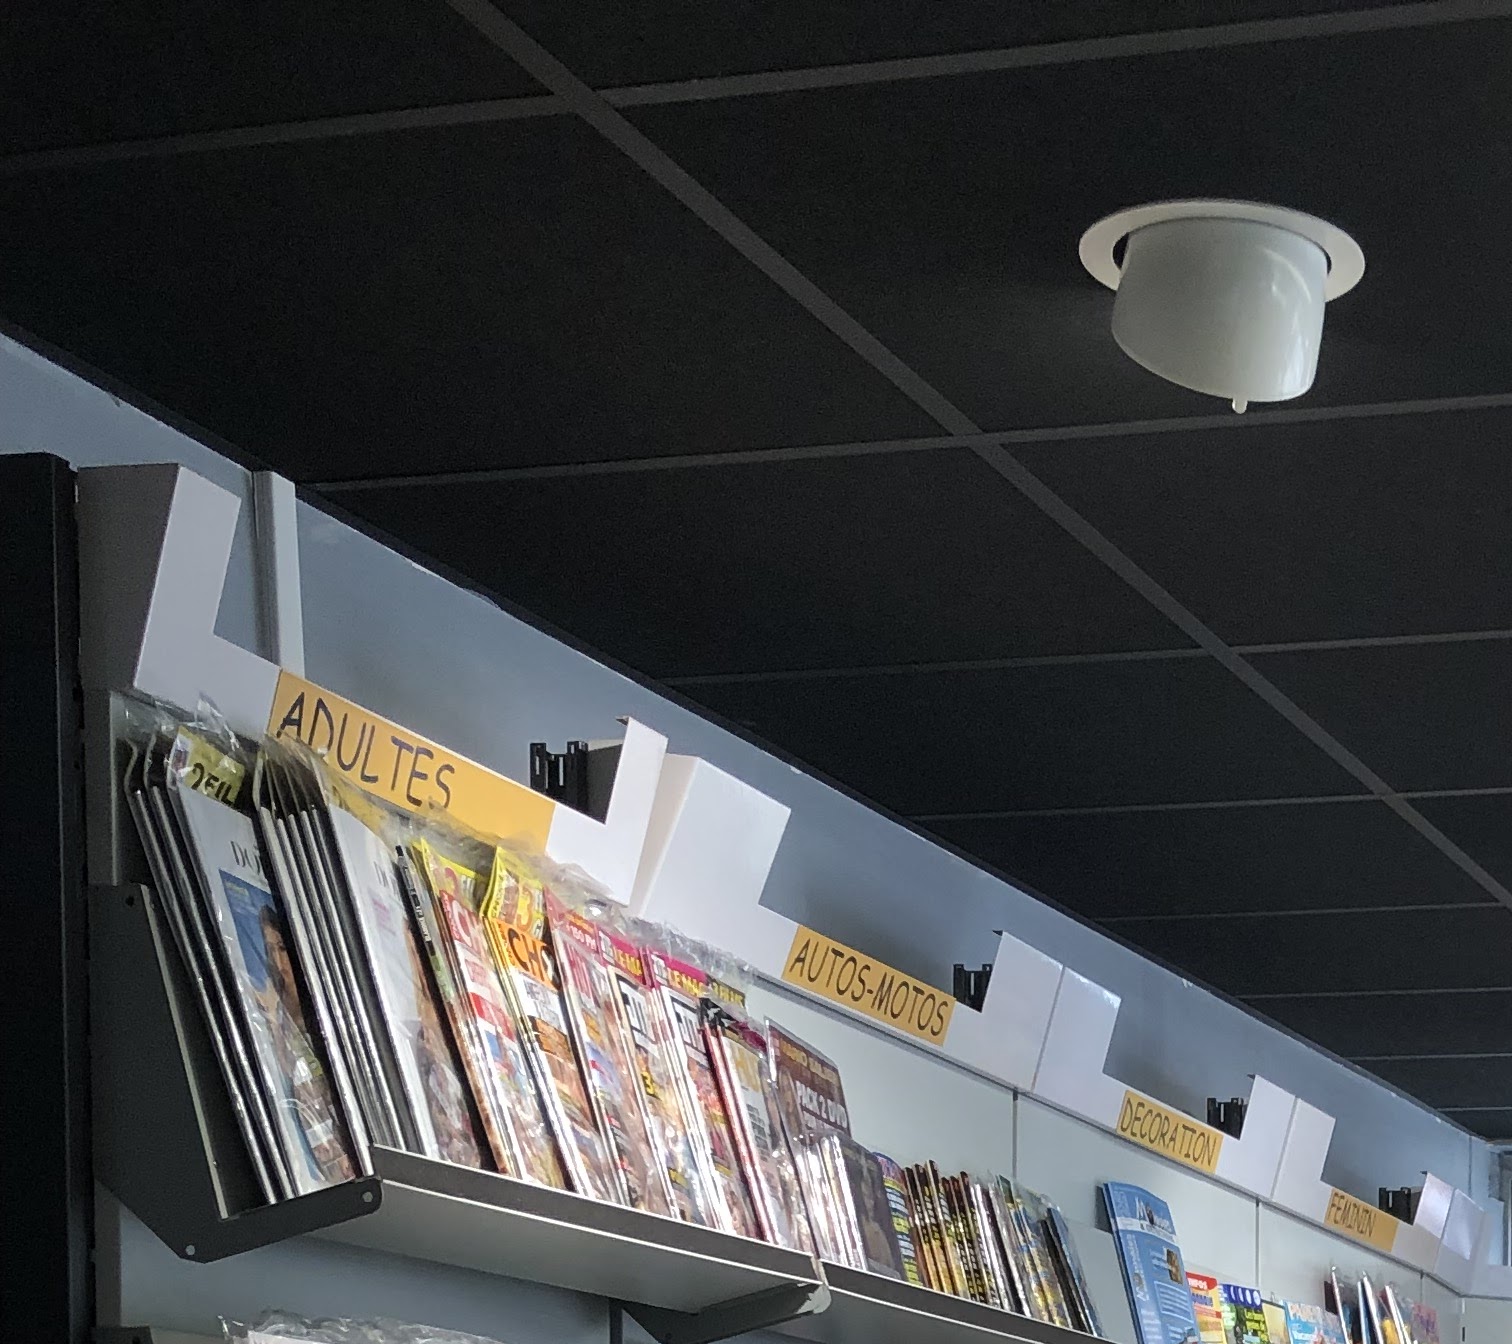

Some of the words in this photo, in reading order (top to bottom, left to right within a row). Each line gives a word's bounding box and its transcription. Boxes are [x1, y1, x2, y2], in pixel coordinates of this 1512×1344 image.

[276, 691, 457, 810] ADULTES
[790, 937, 950, 1037] AUTOS-MOTOS
[1121, 1097, 1216, 1167] DECORATION
[1329, 1192, 1377, 1238] FEMININ
